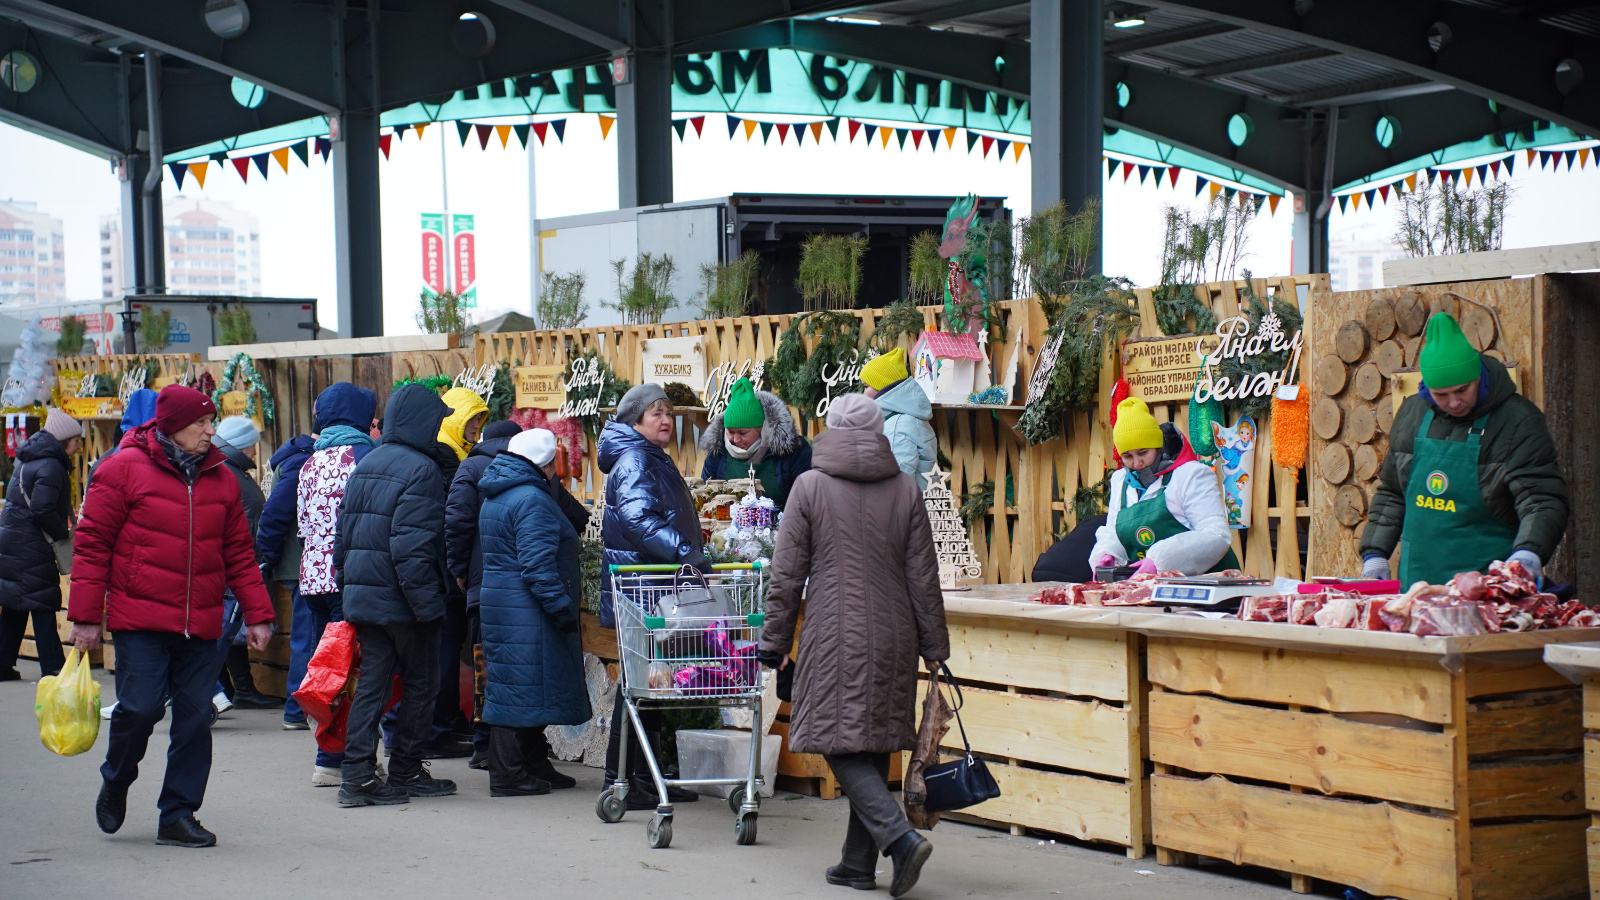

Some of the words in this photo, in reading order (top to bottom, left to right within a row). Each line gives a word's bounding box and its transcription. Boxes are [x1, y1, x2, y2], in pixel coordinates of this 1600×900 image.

[428, 237, 438, 287] ЯРМАРКА
[1196, 315, 1265, 365] Яңа
[1269, 329, 1304, 351] ел
[1133, 344, 1162, 357] РАЙОН
[1150, 353, 1191, 368] ИДӘРӘСЕ
[1127, 374, 1166, 387] РАЙОННОЕ
[1167, 369, 1217, 385] УПРАВЛЕНЕ
[522, 381, 547, 392] ГАНИЕВ
[1143, 382, 1200, 396] ОБРАЗОВАНИ
[925, 499, 956, 509] ӘХЕТ
[1416, 495, 1456, 512] SABA
[930, 521, 963, 531] ТЛЫК
